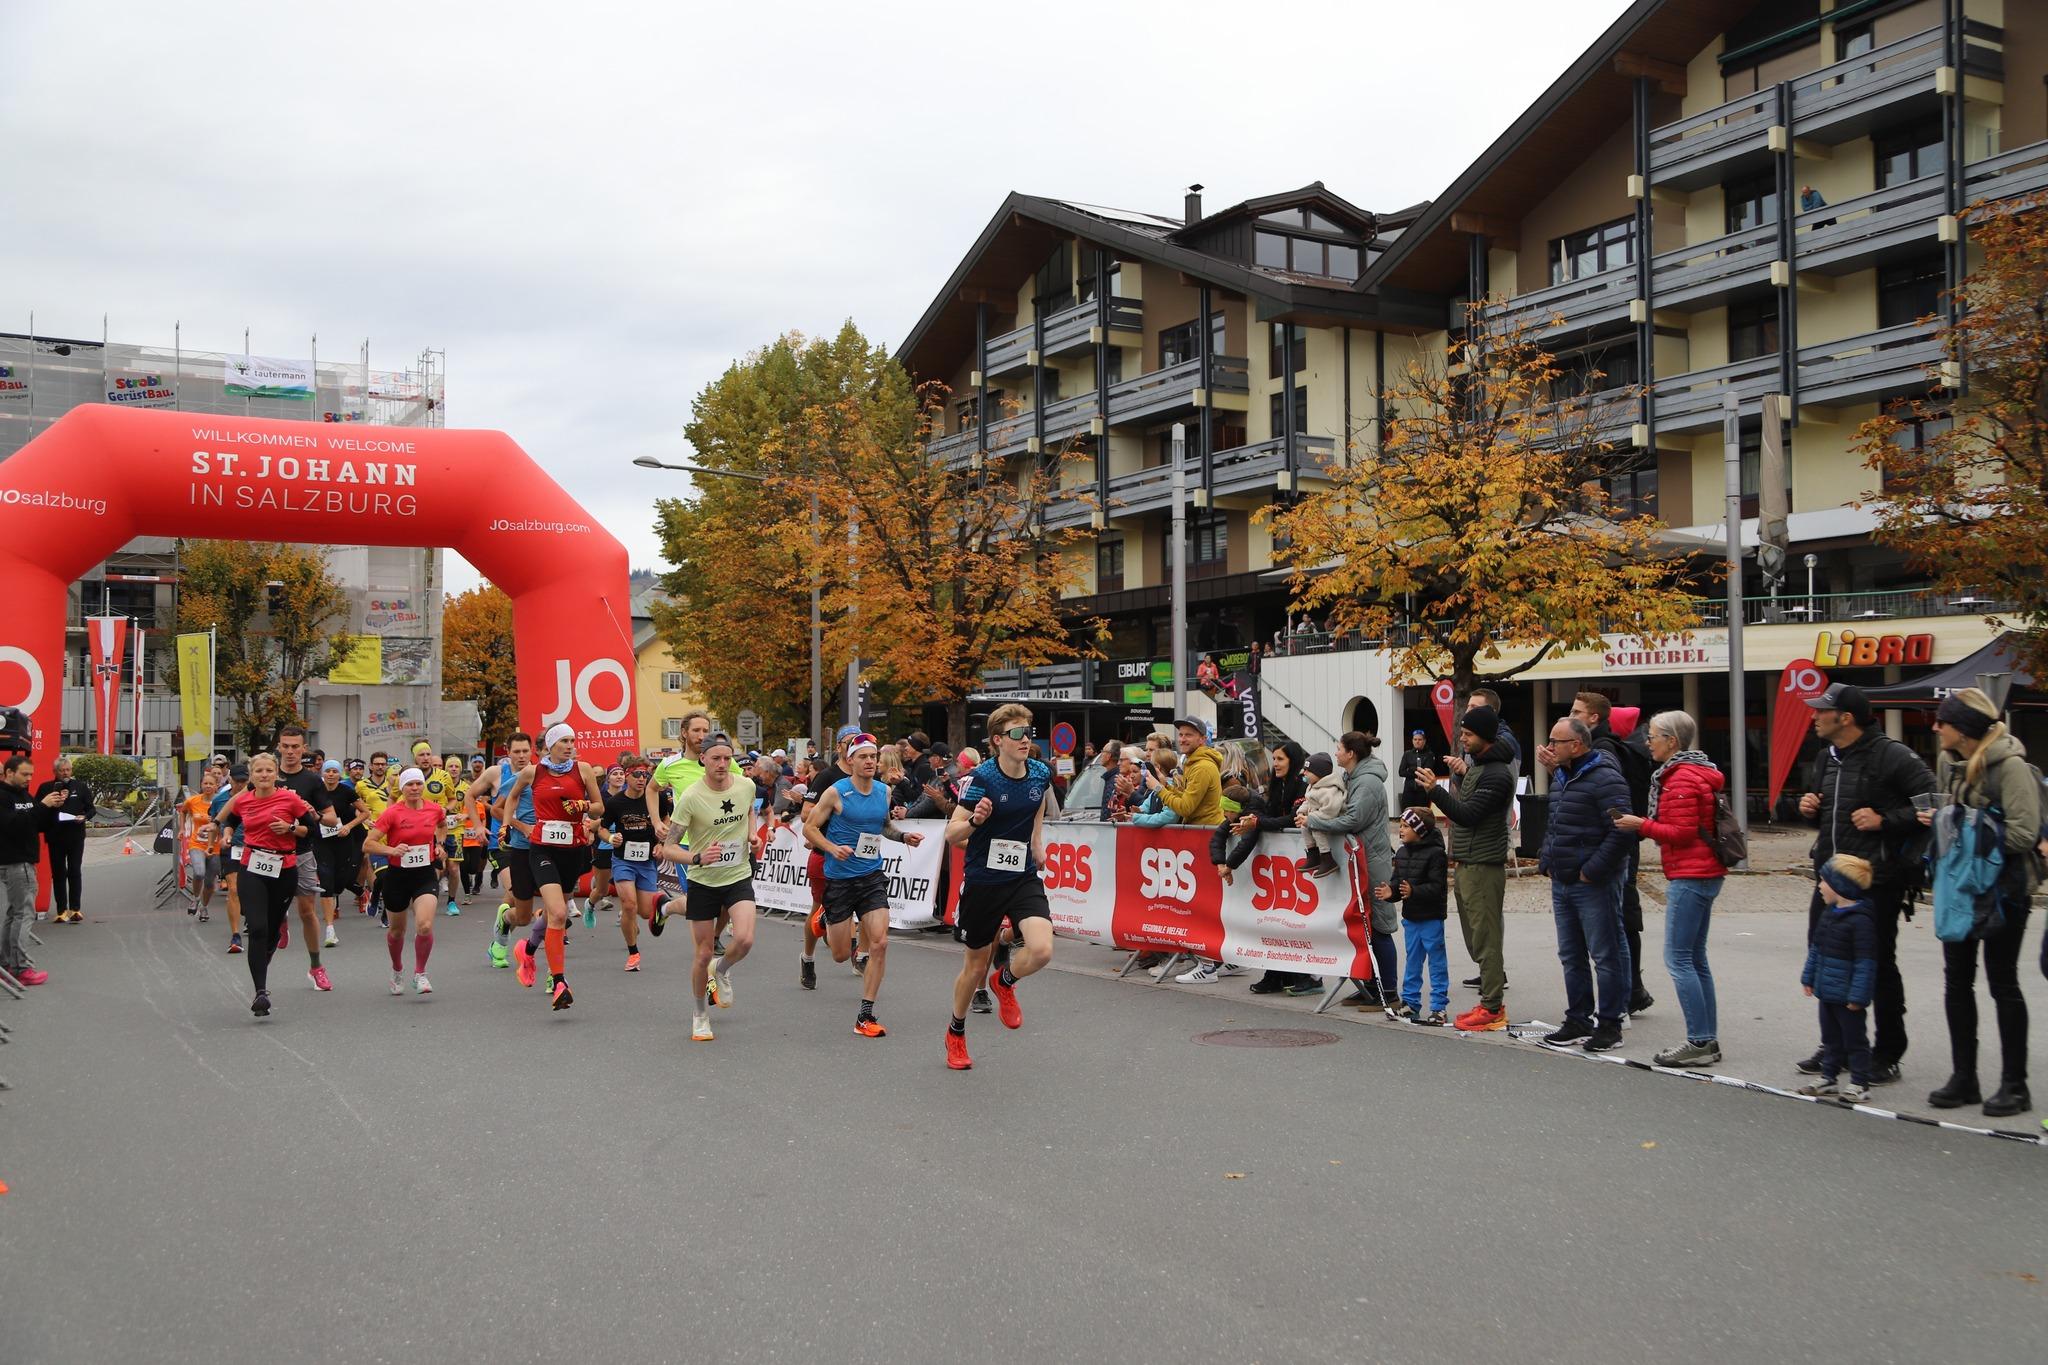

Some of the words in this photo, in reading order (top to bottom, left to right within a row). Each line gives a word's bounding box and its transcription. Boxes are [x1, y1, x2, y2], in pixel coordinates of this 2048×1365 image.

[115, 375, 162, 389] Strobl
[254, 370, 306, 380] tautermann
[108, 389, 175, 402] GerüstBau.
[192, 428, 317, 447] WILLKOMMEN
[328, 438, 416, 454] WELCOME
[192, 451, 247, 477] ST.
[257, 455, 417, 486] JOHANN
[191, 483, 223, 506] IN
[235, 485, 417, 516] SALZBURG
[489, 519, 591, 534] JOsalzburg.com
[1605, 649, 1709, 668] SCHIEBEL
[1784, 668, 1821, 692] JO
[541, 658, 631, 727] JO
[577, 731, 595, 739] ST.
[597, 729, 634, 738] JOHANN
[577, 741, 589, 749] IN
[591, 739, 635, 748] SALZBURG
[713, 814, 744, 826] SAYSKY
[549, 831, 567, 840] 310
[630, 850, 644, 858] 312
[764, 844, 792, 865] Sport
[862, 845, 877, 855] 326
[408, 855, 424, 864] 315
[882, 855, 902, 874] ort
[997, 853, 1019, 866] 348
[255, 861, 273, 873] 303
[1044, 842, 1092, 893] SBS
[1140, 847, 1197, 903] SBS
[1251, 854, 1319, 916] SBS
[1142, 923, 1166, 934] REGIONALE
[1261, 937, 1289, 948] REGIONALE
[1244, 948, 1264, 958] Johann
[1267, 950, 1303, 962] Bischofshofen
[1306, 953, 1338, 965] Schwarzach
